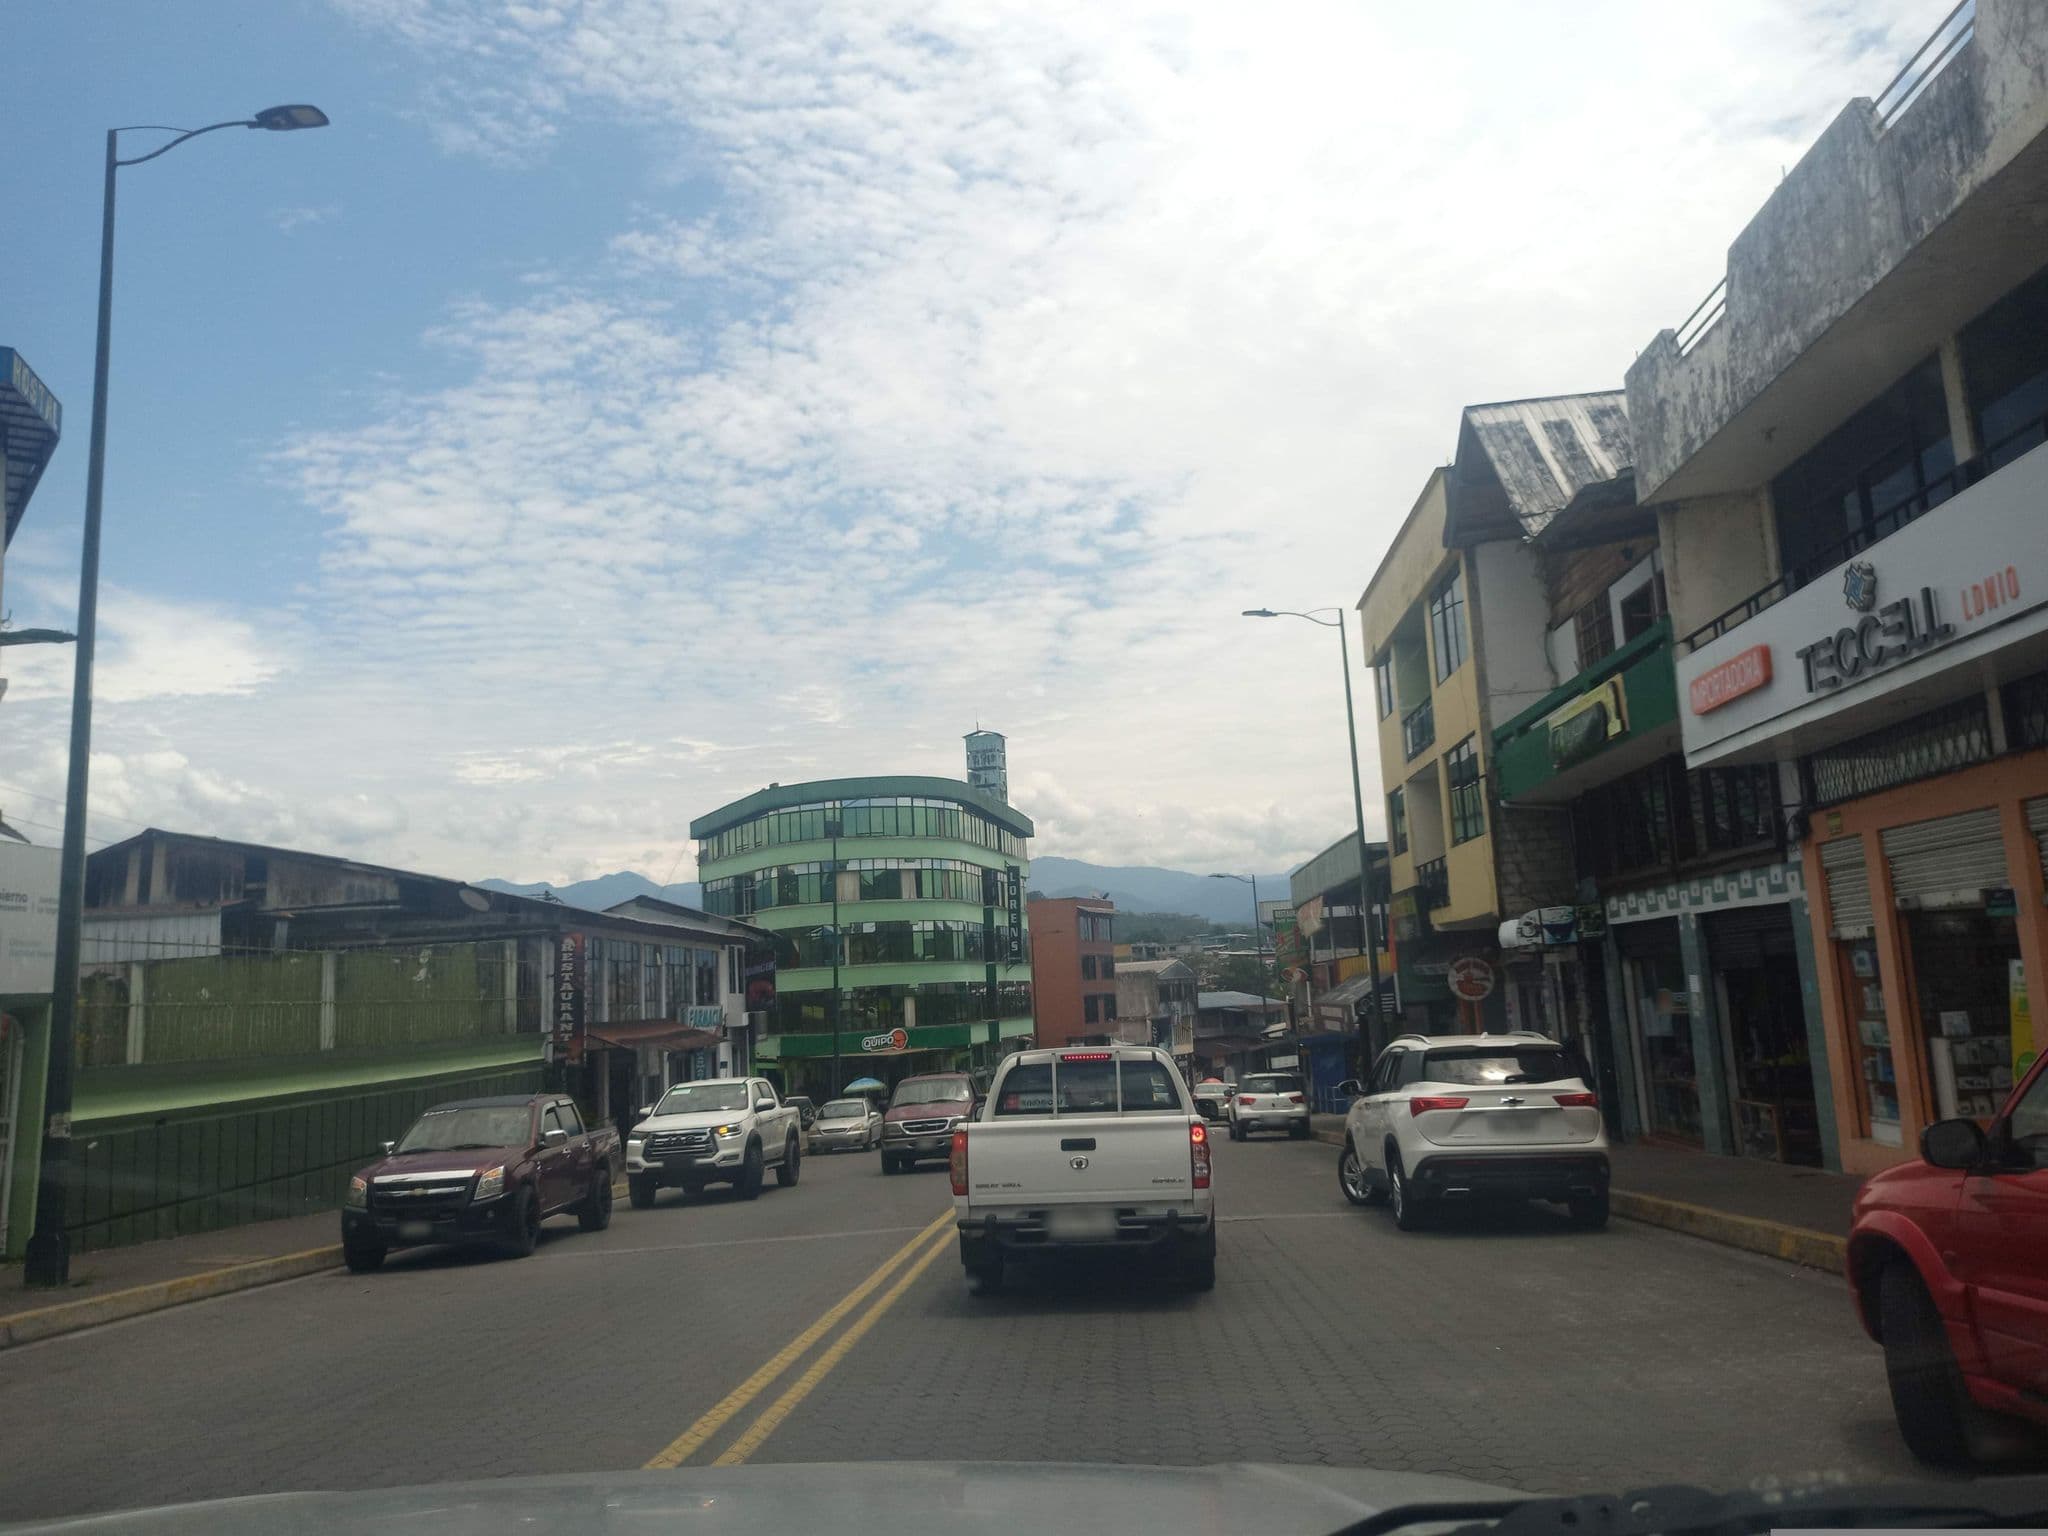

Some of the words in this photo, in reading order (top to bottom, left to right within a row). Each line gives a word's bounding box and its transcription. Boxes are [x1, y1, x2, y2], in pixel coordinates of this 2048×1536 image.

[1795, 585, 1956, 693] TECCELL
[1009, 871, 1019, 952] LORENS
[560, 938, 576, 1042] RESTAURANT
